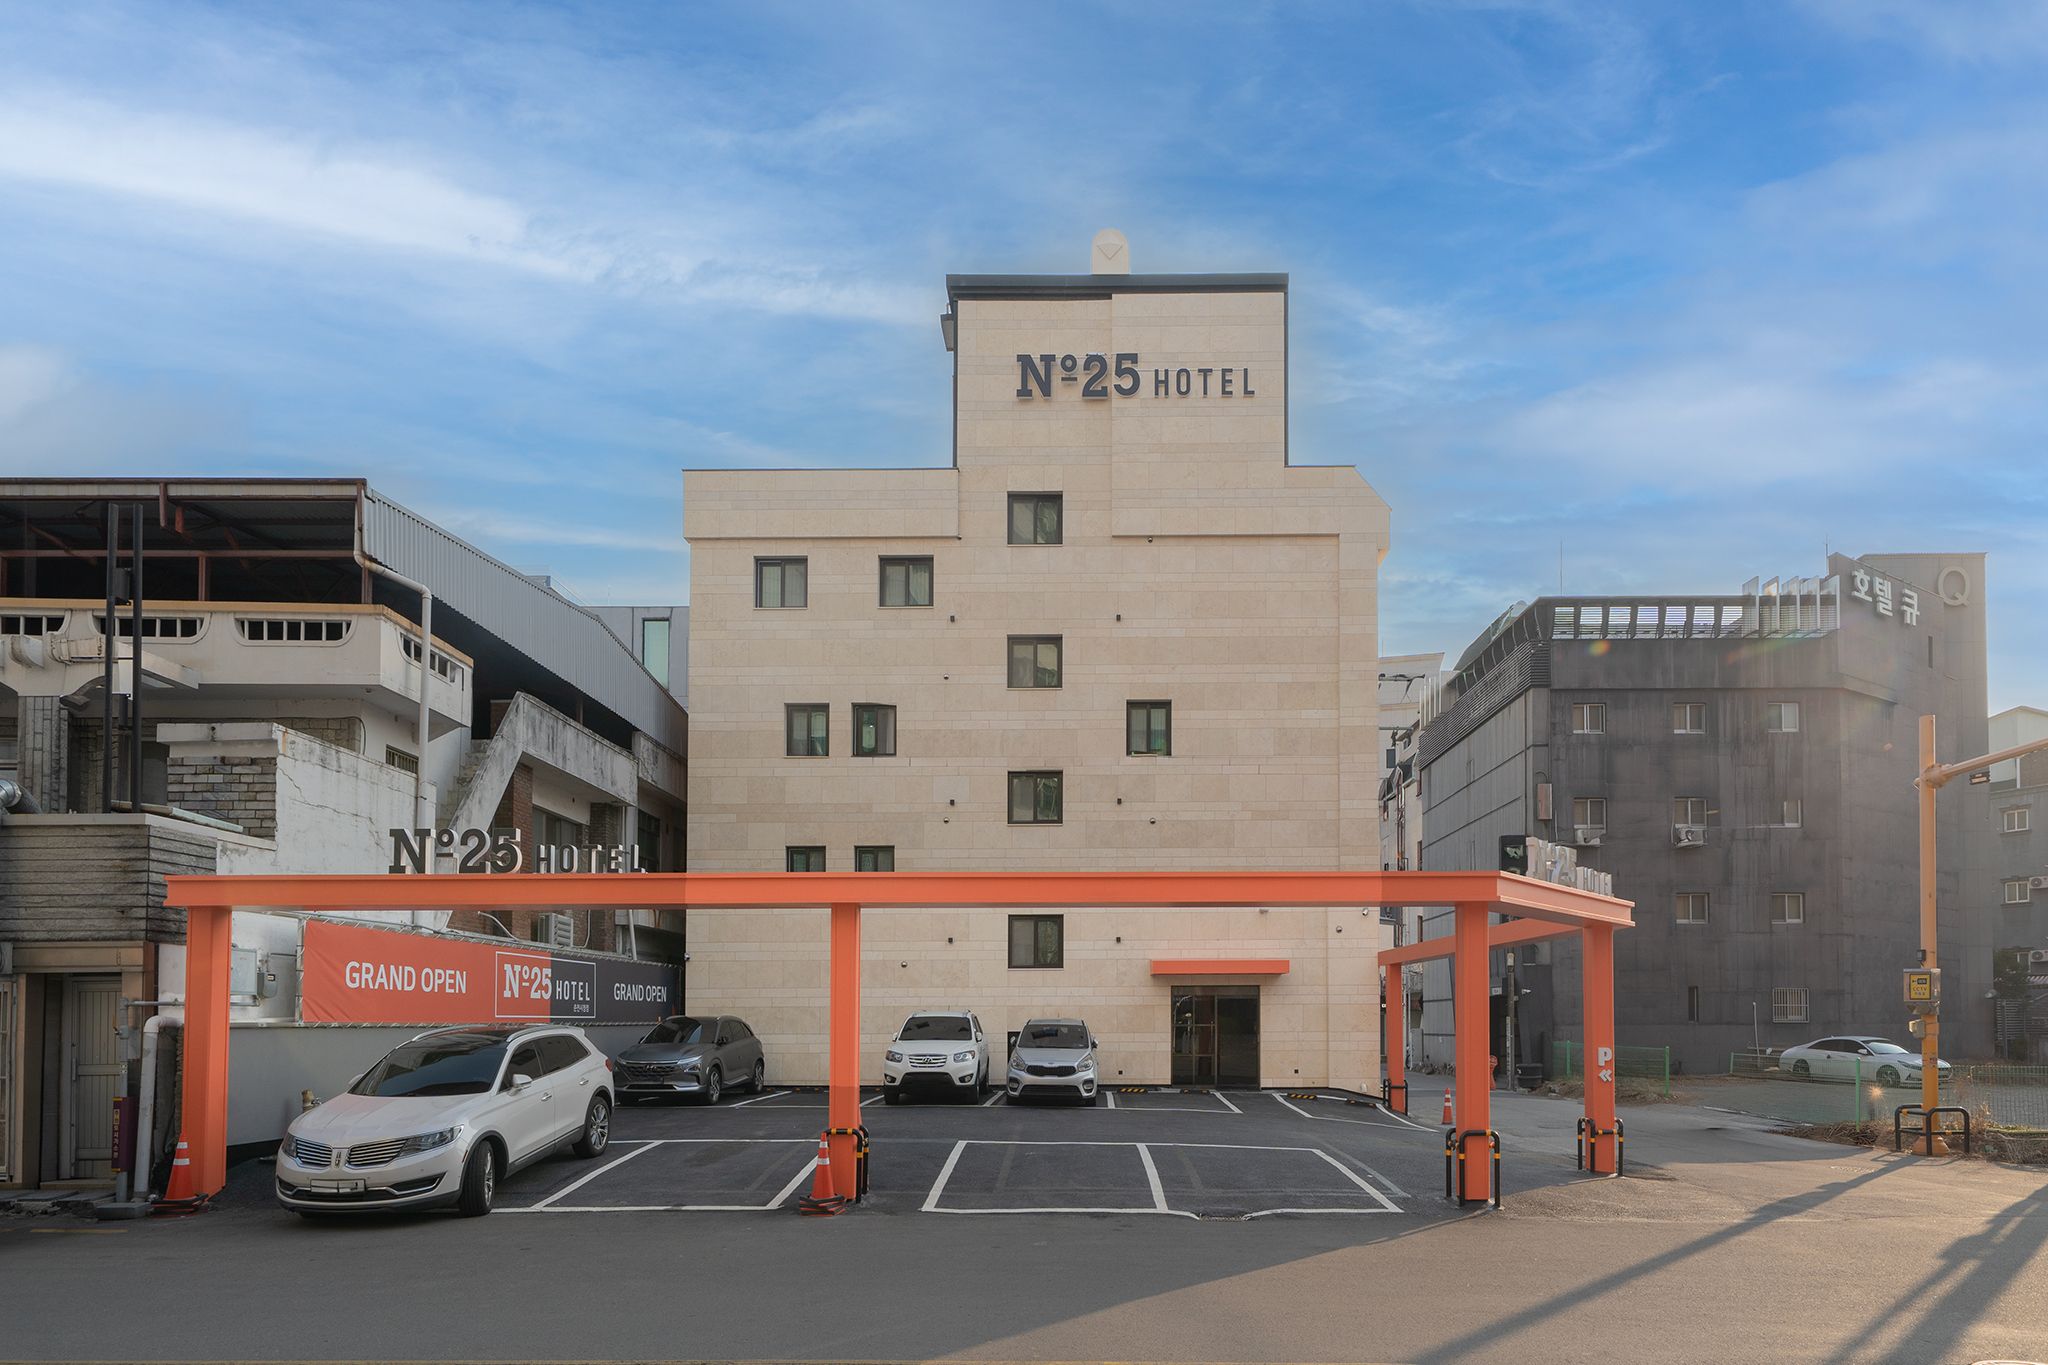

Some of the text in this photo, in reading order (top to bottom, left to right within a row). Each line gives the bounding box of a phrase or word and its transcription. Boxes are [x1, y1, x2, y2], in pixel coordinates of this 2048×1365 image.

[1154, 368, 1255, 398] HOTEL
[1851, 568, 1894, 617] 호텔
[1937, 566, 1971, 607] Q
[537, 844, 648, 874] HOTEL
[345, 961, 467, 993] GRAND OPEN
[556, 980, 590, 1001] HOTEL
[613, 983, 667, 1002] GRAND OPEN
[1597, 1047, 1612, 1066] P
